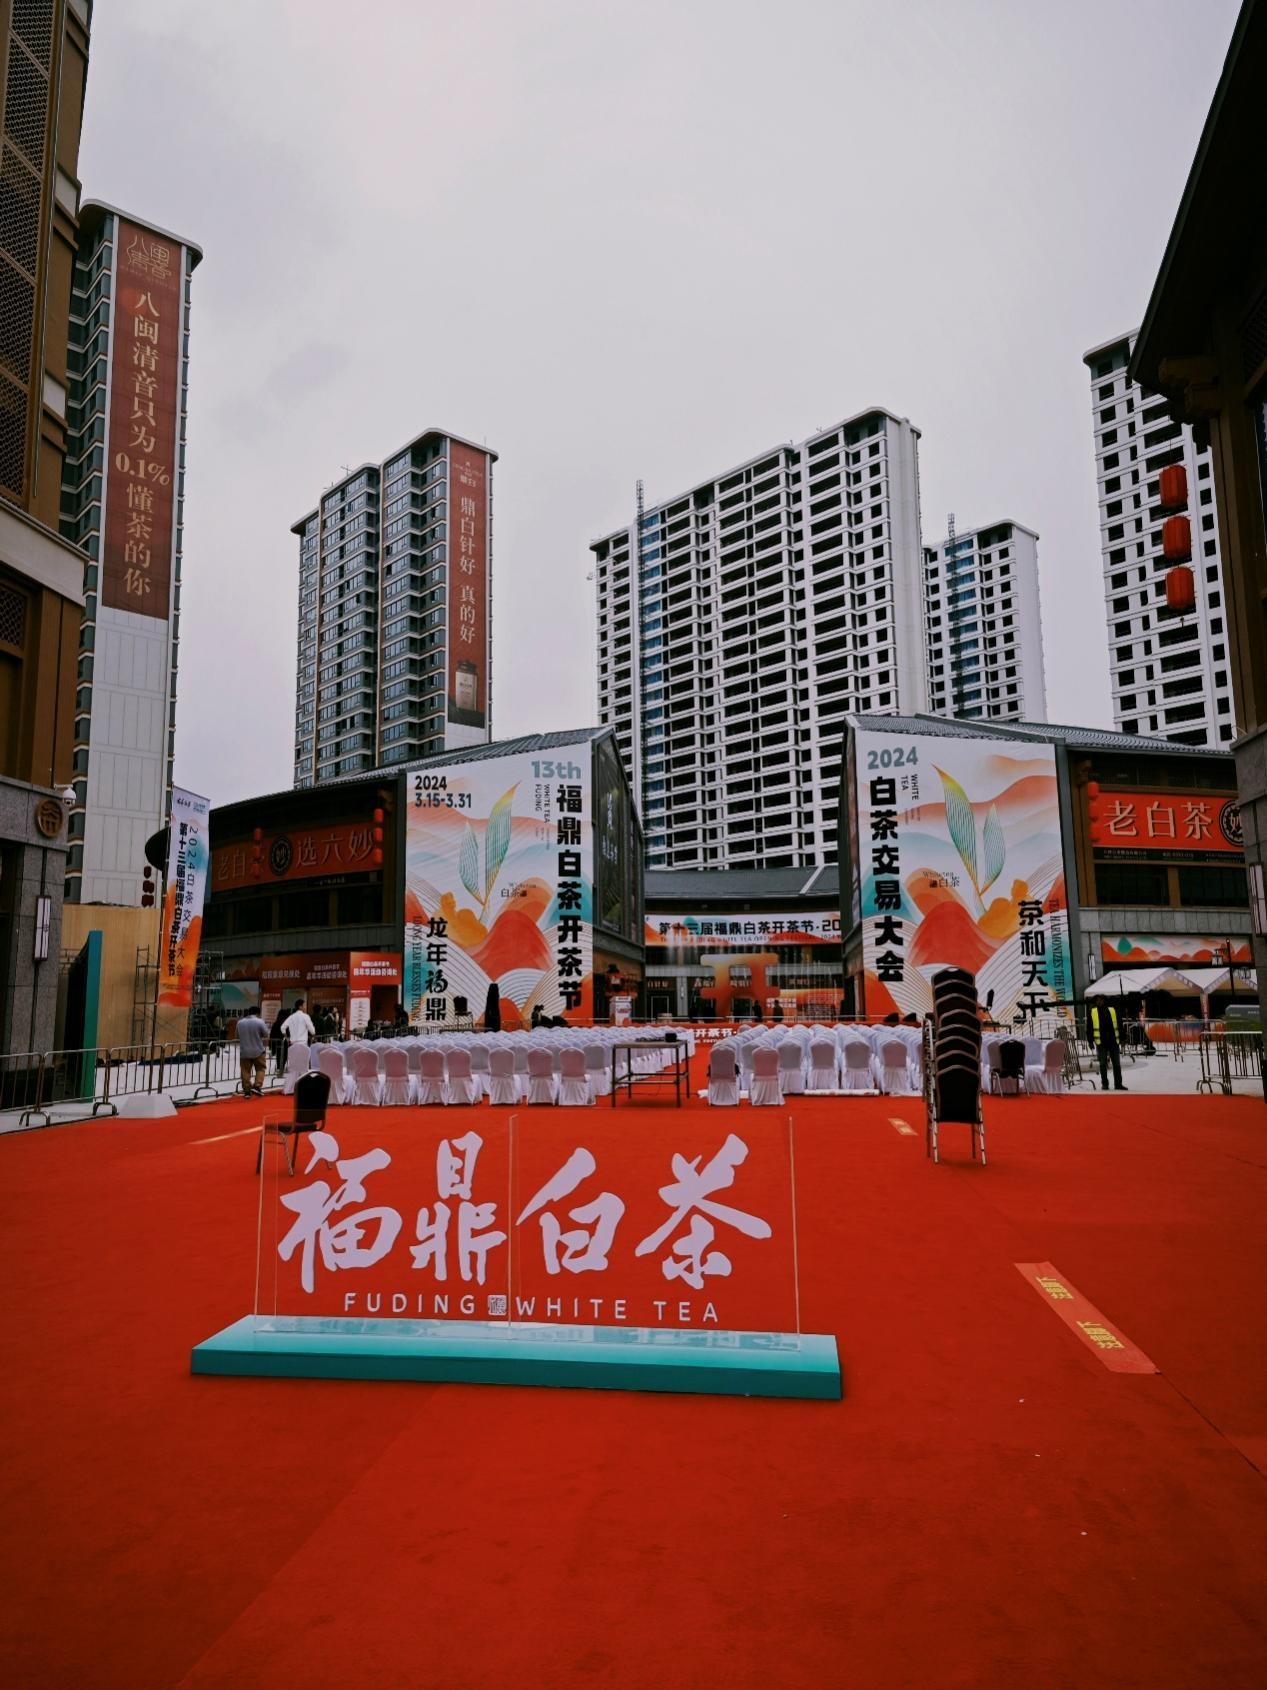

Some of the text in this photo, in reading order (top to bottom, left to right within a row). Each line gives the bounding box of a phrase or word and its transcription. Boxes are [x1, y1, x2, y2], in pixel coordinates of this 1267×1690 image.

[531, 760, 582, 780] 13th
[866, 746, 919, 770] 2024
[415, 775, 448, 791] 2024
[543, 783, 551, 808] WHITE
[901, 775, 909, 791] TEA
[911, 773, 919, 801] WHITE
[415, 792, 472, 809] 3.15-3.31
[535, 783, 543, 812] FUDING
[543, 809, 551, 824] TEA
[1103, 800, 1213, 841] 老白茶
[869, 776, 904, 983] 白茶交易大会
[556, 784, 583, 1011] 福鼎白茶开茶节
[424, 916, 449, 1022] 龙年福鼎
[277, 1131, 772, 1293] 福鼎白茶
[344, 1292, 476, 1315] FUDING
[516, 1296, 627, 1320] WHITE
[656, 1300, 719, 1323] TEA
